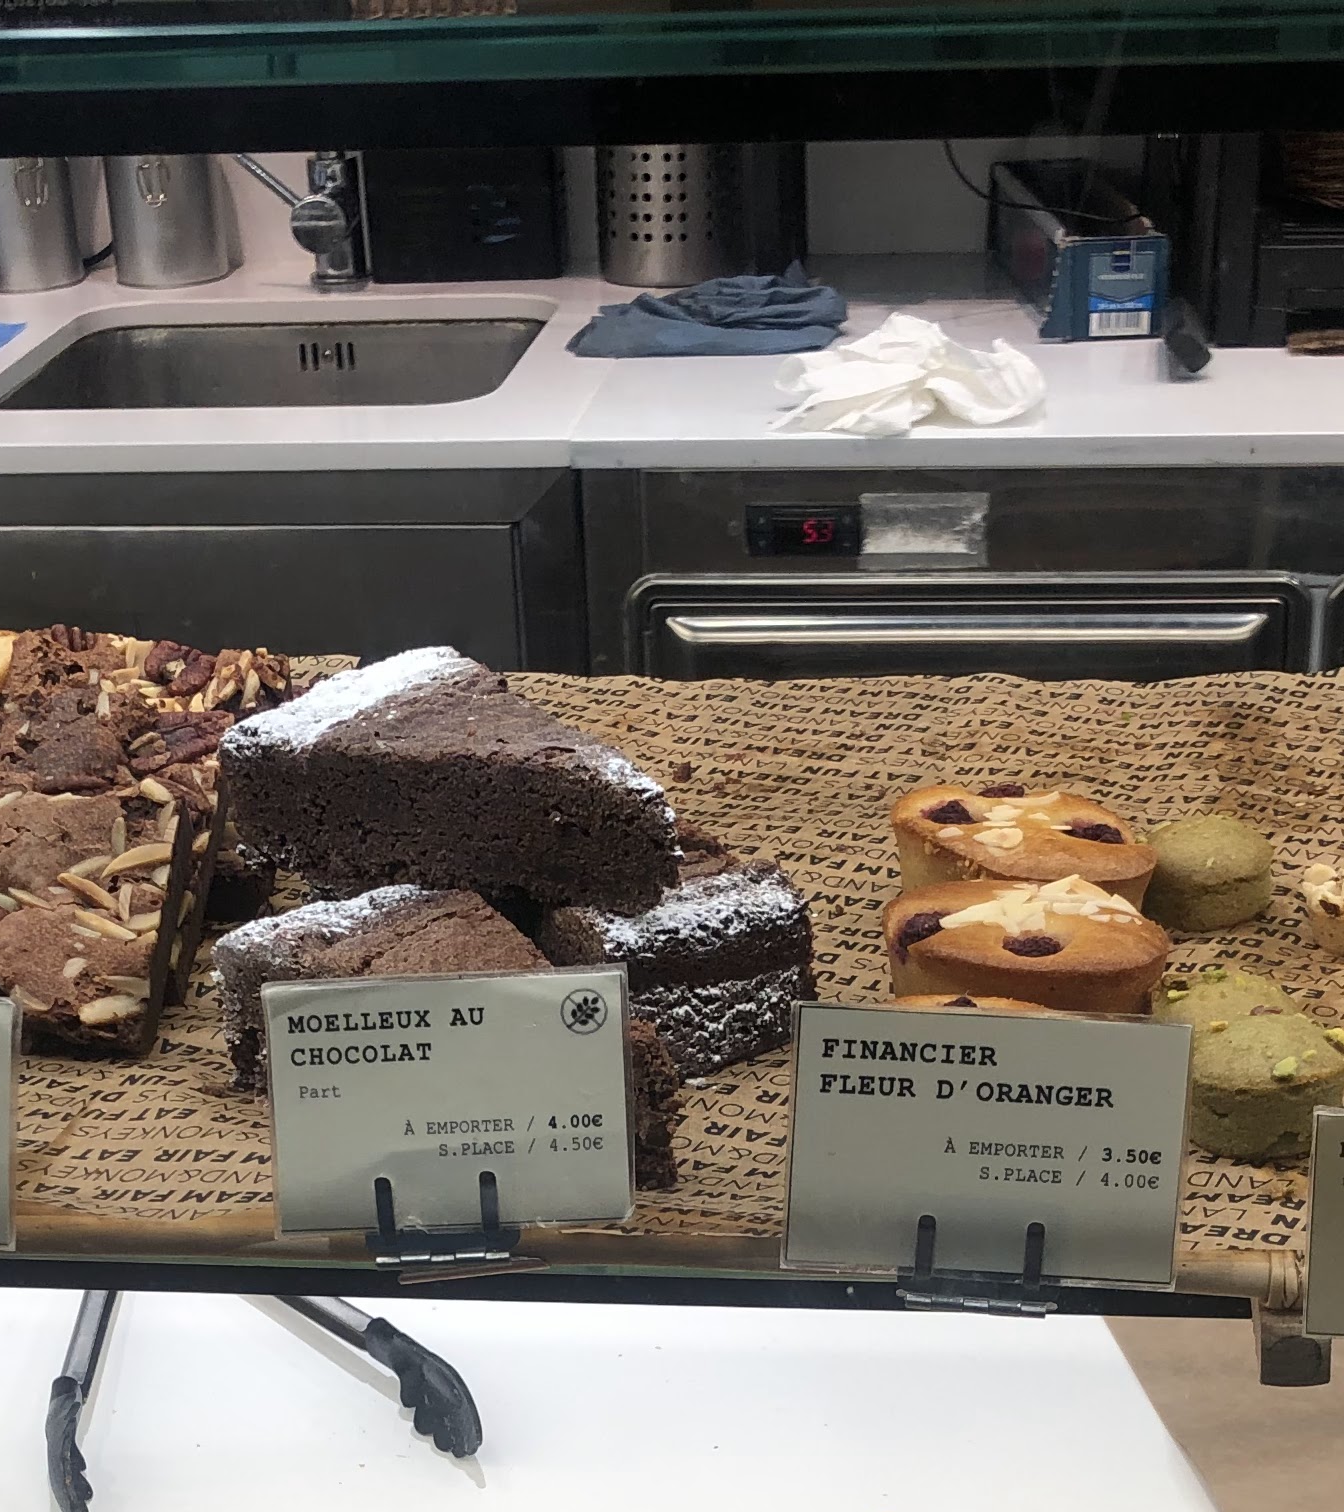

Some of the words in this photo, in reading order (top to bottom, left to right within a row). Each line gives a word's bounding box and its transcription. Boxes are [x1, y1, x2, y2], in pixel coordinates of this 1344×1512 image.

[287, 1009, 431, 1036] MOELLEUX
[449, 1007, 485, 1027] AU
[290, 1042, 432, 1068] CHOCOLAT
[821, 1038, 998, 1067] FINANCIER
[298, 1084, 342, 1100] Part
[819, 1073, 917, 1099] FLEUR
[935, 1078, 1115, 1109] D'ORANGER
[403, 1119, 416, 1137] À
[426, 1118, 515, 1136] EMPORTER
[526, 1116, 537, 1133] /
[547, 1113, 604, 1131] 4.00€
[438, 1139, 515, 1157] S.PLACE
[527, 1138, 537, 1154] /
[549, 1135, 604, 1153] 4.50€
[944, 1137, 957, 1155] À
[968, 1141, 1065, 1161] EMPORTER
[1077, 1145, 1088, 1163] /
[1101, 1146, 1162, 1166] 3.50€
[979, 1166, 1062, 1185] S.PLACE
[1075, 1169, 1086, 1188] /
[1100, 1171, 1160, 1190] 4.00€
